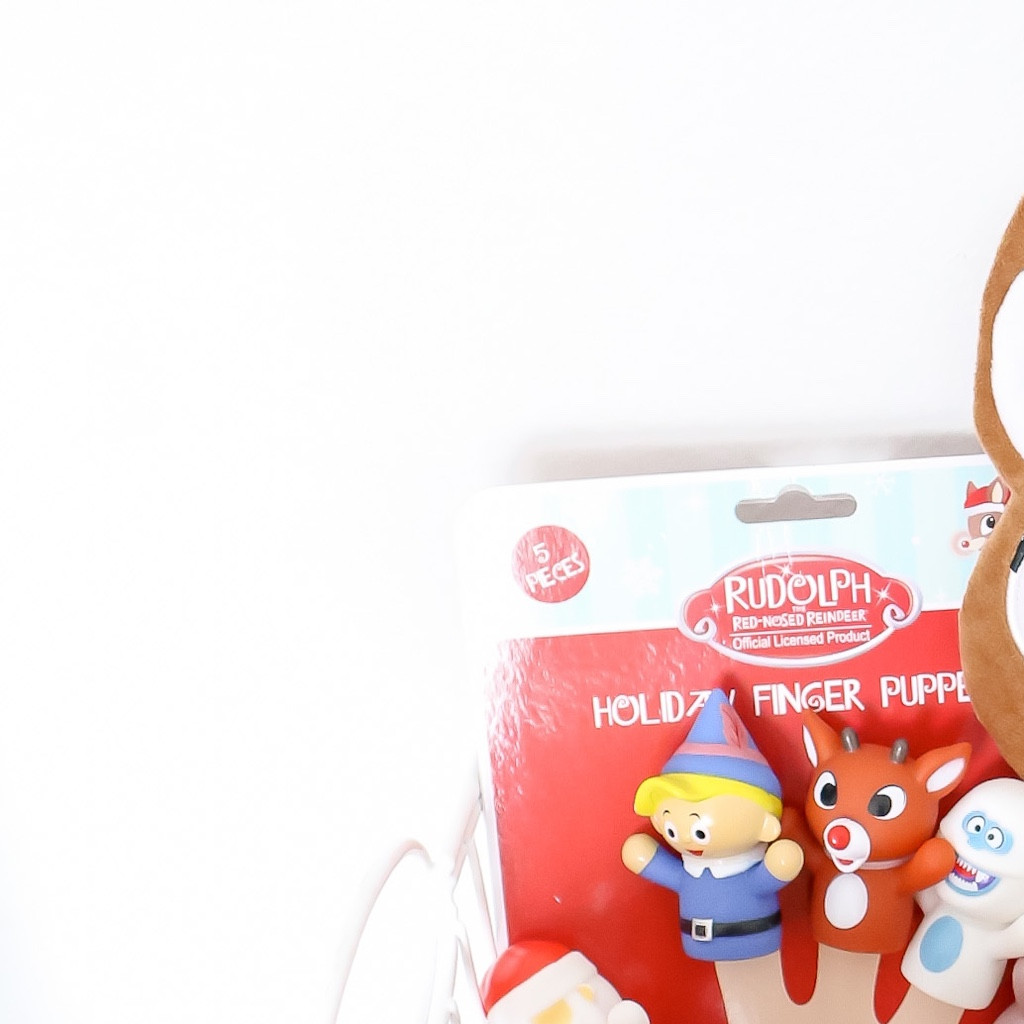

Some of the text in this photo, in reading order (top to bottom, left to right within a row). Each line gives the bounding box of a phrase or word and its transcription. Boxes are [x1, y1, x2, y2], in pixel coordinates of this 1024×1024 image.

[532, 542, 550, 564] 5
[525, 552, 585, 593] PIECES
[724, 569, 872, 614] RUDOLPH
[732, 609, 866, 632] RED-NOSED REINDEER
[732, 630, 871, 650] Official Licensed Product
[752, 678, 866, 717] FINGER
[880, 670, 971, 709] PUPPE
